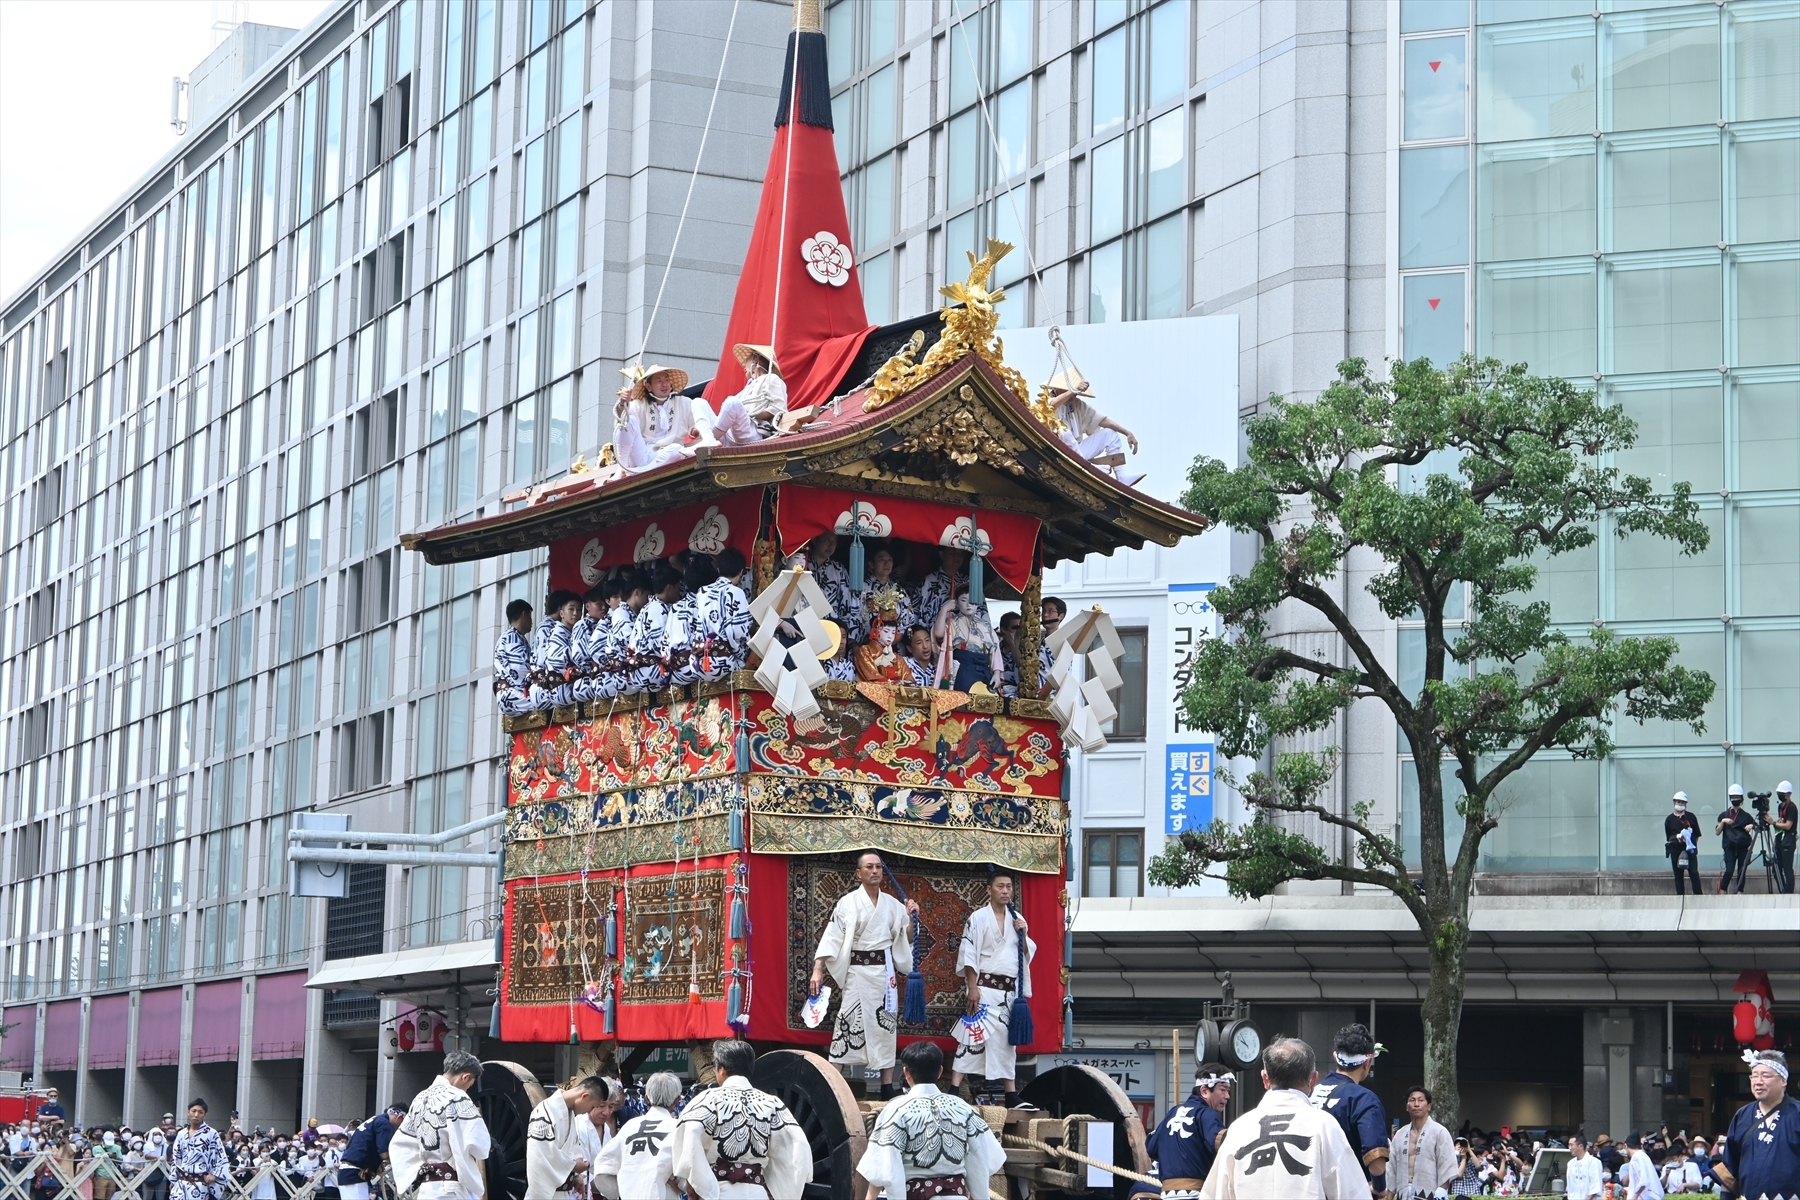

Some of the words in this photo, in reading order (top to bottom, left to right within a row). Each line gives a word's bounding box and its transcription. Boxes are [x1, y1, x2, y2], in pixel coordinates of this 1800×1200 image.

[1170, 752, 1188, 831] 買えます
[1191, 754, 1207, 793] すぐ
[1081, 1059, 1141, 1068] メガネスーパー
[1234, 1113, 1313, 1176] 長
